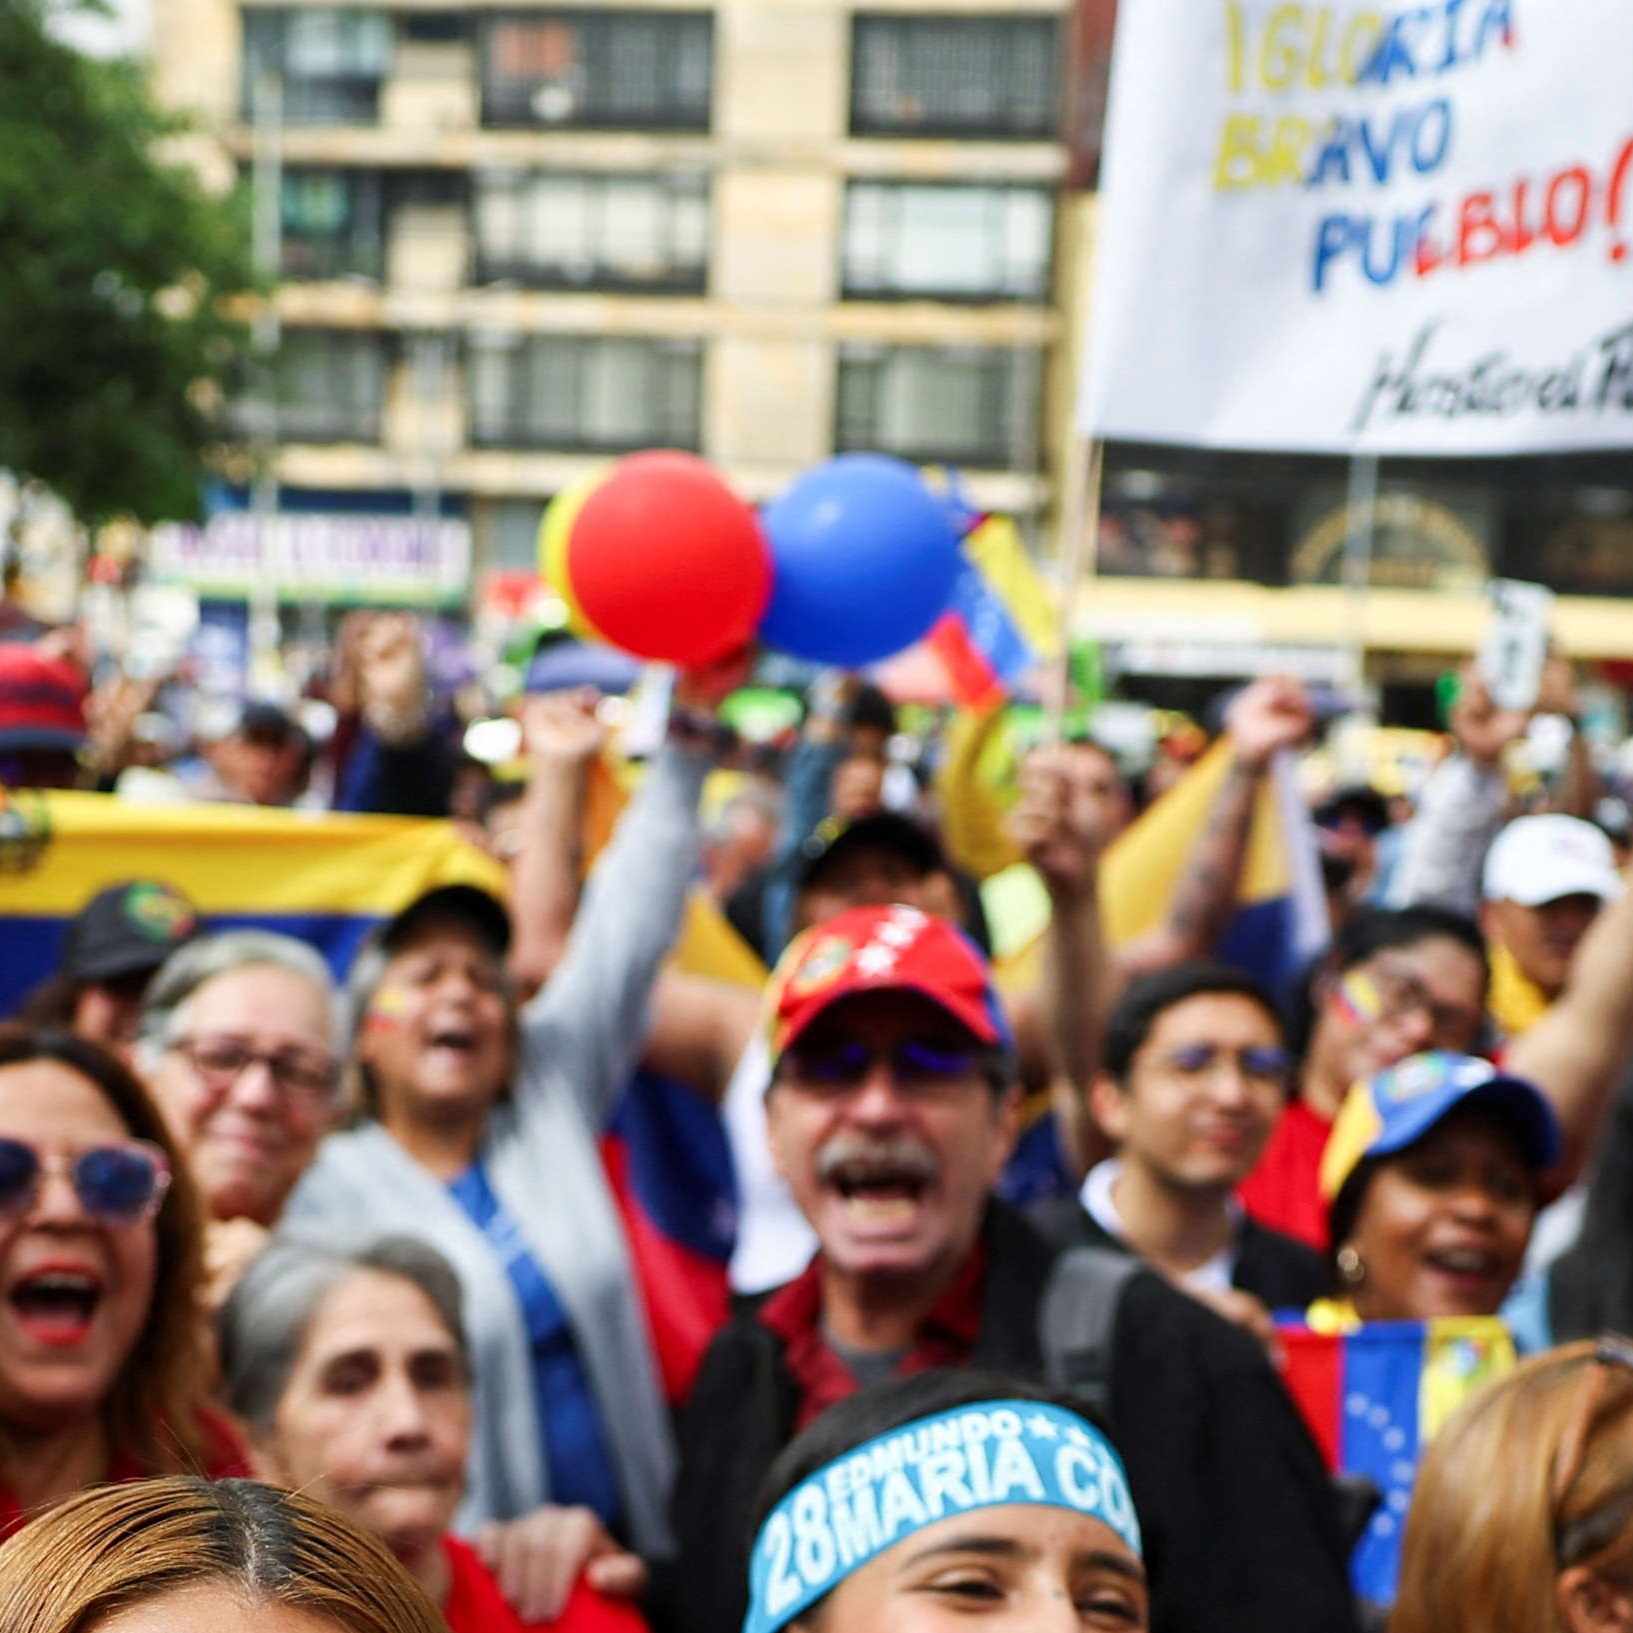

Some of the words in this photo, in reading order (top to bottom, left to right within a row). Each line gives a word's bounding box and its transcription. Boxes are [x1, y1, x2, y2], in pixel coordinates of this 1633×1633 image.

[1213, 98, 1453, 190] BRAVO
[823, 1408, 1024, 1500] EDMUNDO
[763, 1482, 839, 1618] 28
[830, 1436, 1047, 1566] MARIA
[1054, 1443, 1142, 1558] CO
